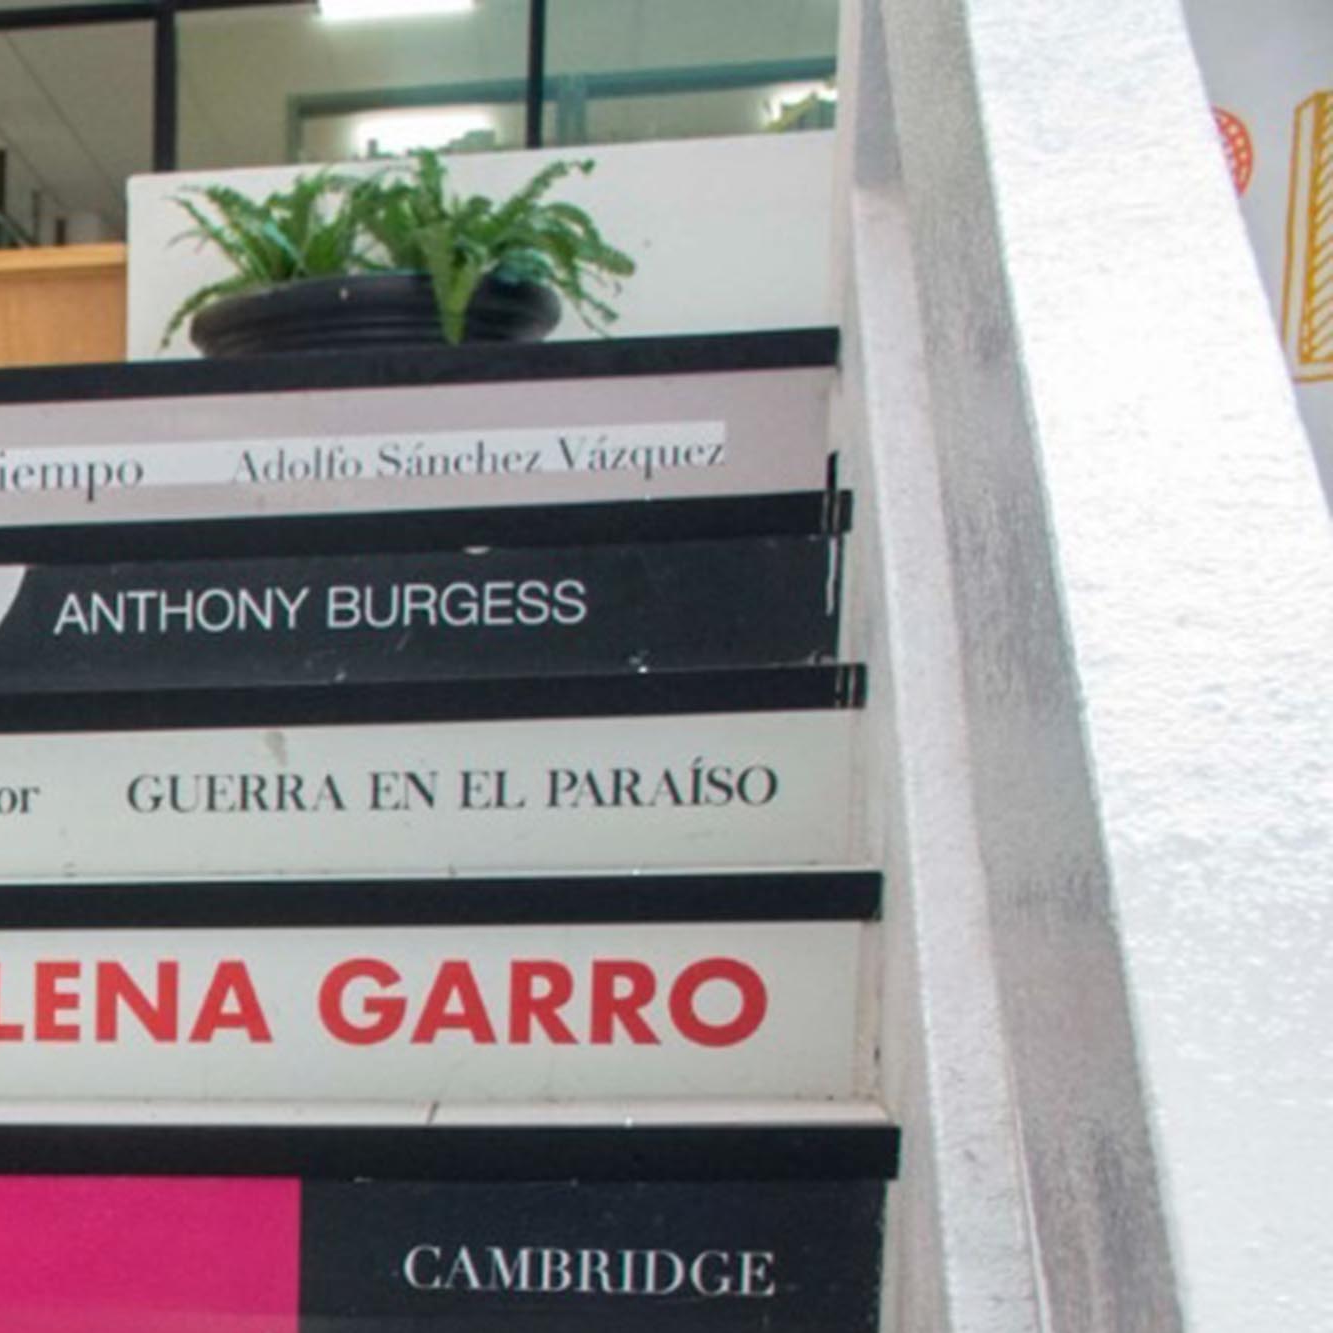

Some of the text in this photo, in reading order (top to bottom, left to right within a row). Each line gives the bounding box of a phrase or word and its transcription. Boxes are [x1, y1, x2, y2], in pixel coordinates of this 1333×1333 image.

[235, 434, 726, 484] Adolfo Sánchez Vázquez
[53, 580, 587, 635] ANTHONY BURGESS
[127, 757, 780, 813] GUERRA EN EL PARAÍSO
[318, 957, 768, 1048] GARRO
[403, 1245, 776, 1297] CAMBRIDGE
